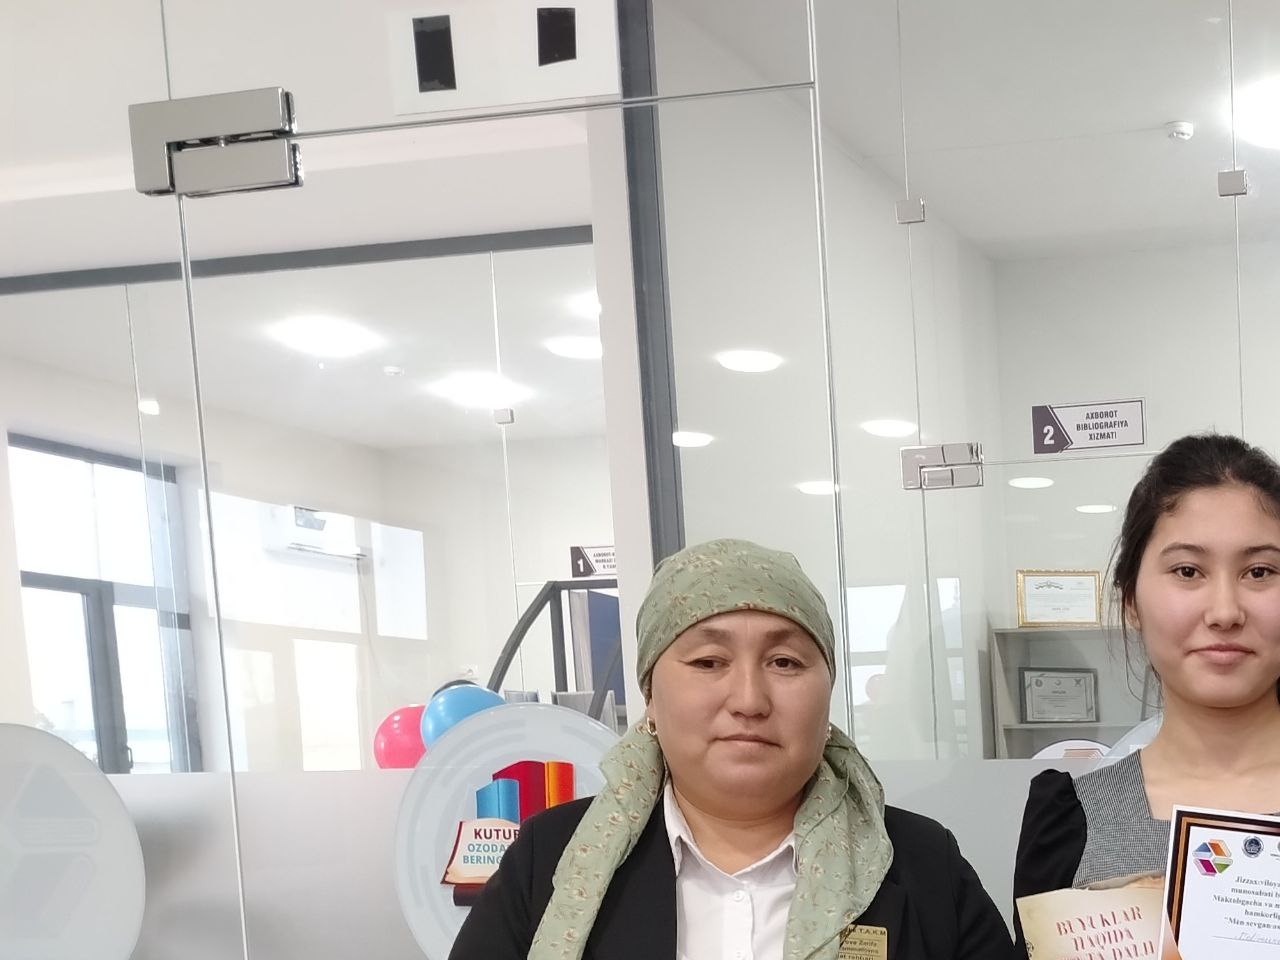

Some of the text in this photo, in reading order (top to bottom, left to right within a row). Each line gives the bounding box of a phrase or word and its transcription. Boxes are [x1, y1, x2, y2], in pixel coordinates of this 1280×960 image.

[1085, 410, 1118, 420] AXBOROT
[1076, 420, 1129, 431] BIBLIOGRAFIYA
[1042, 425, 1055, 445] 2
[1088, 432, 1117, 441] XIZMATI
[577, 558, 584, 573] 1
[467, 843, 511, 853] OZODA
[1246, 920, 1271, 930] sevgan
[1073, 929, 1134, 952] HAQIDA
